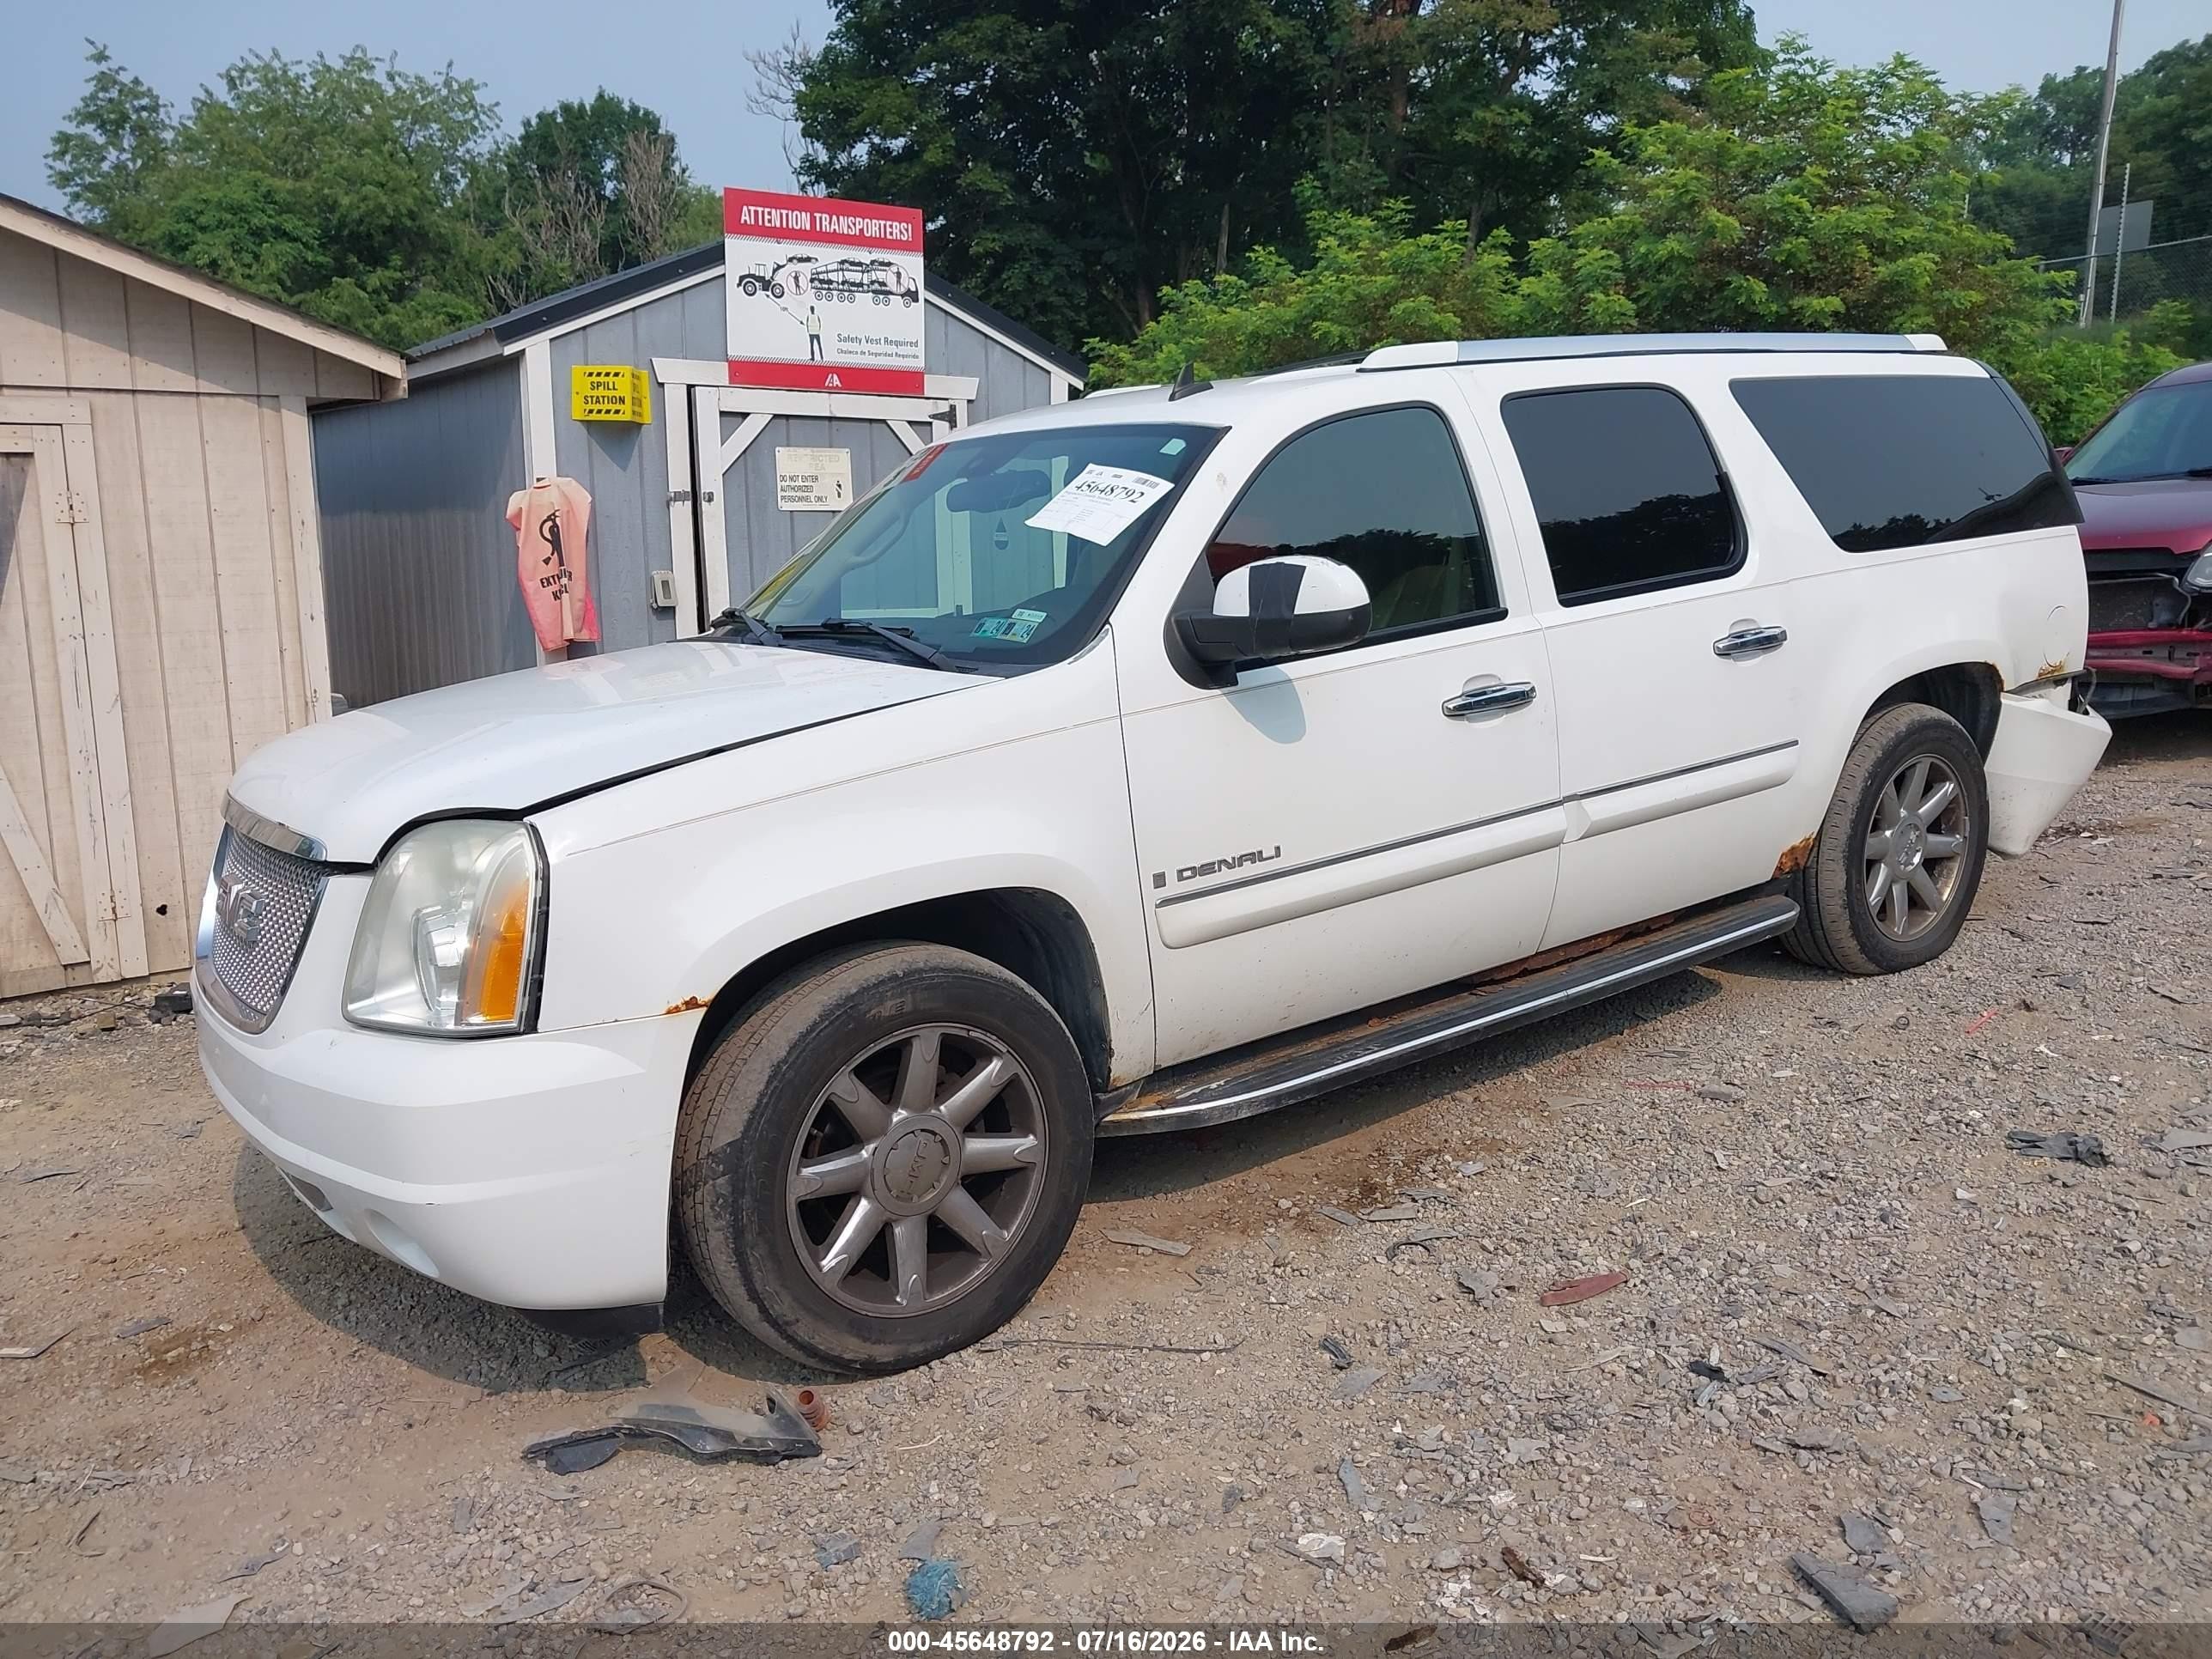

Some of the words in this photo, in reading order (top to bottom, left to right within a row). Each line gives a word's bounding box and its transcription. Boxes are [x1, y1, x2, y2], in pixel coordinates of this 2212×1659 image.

[740, 205, 811, 231] ATTENTION
[814, 212, 913, 241] TRANSPORTERS!
[836, 333, 862, 346] Safety
[864, 336, 882, 345] Vest
[884, 337, 919, 349] Required
[867, 350, 894, 359] Seguridad
[590, 381, 618, 391] SPILL
[583, 395, 625, 405] STATION
[1075, 479, 1145, 503] 45648792
[1020, 623, 1036, 638] 24
[1176, 845, 1281, 882] DENALI
